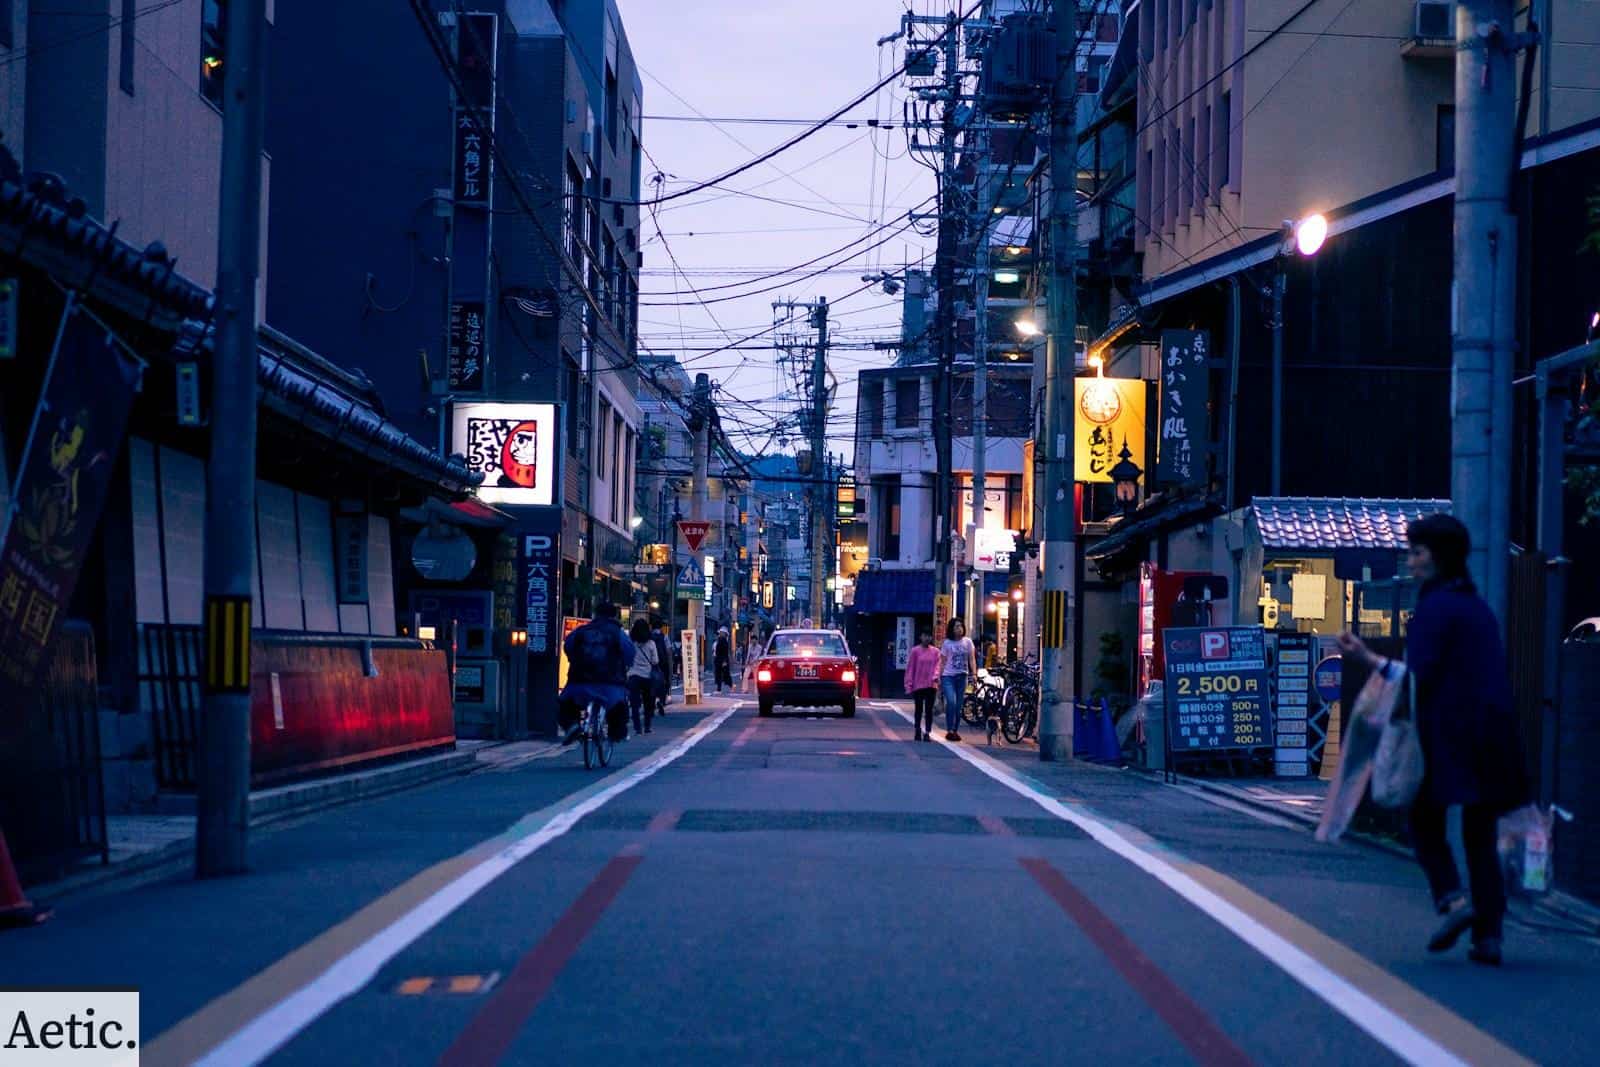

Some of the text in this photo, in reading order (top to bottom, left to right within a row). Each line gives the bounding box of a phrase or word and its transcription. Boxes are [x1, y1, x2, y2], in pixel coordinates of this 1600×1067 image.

[464, 132, 480, 197] 六角ビル
[1164, 345, 1188, 439] おかき処
[525, 536, 552, 558] P
[1203, 634, 1226, 657] P
